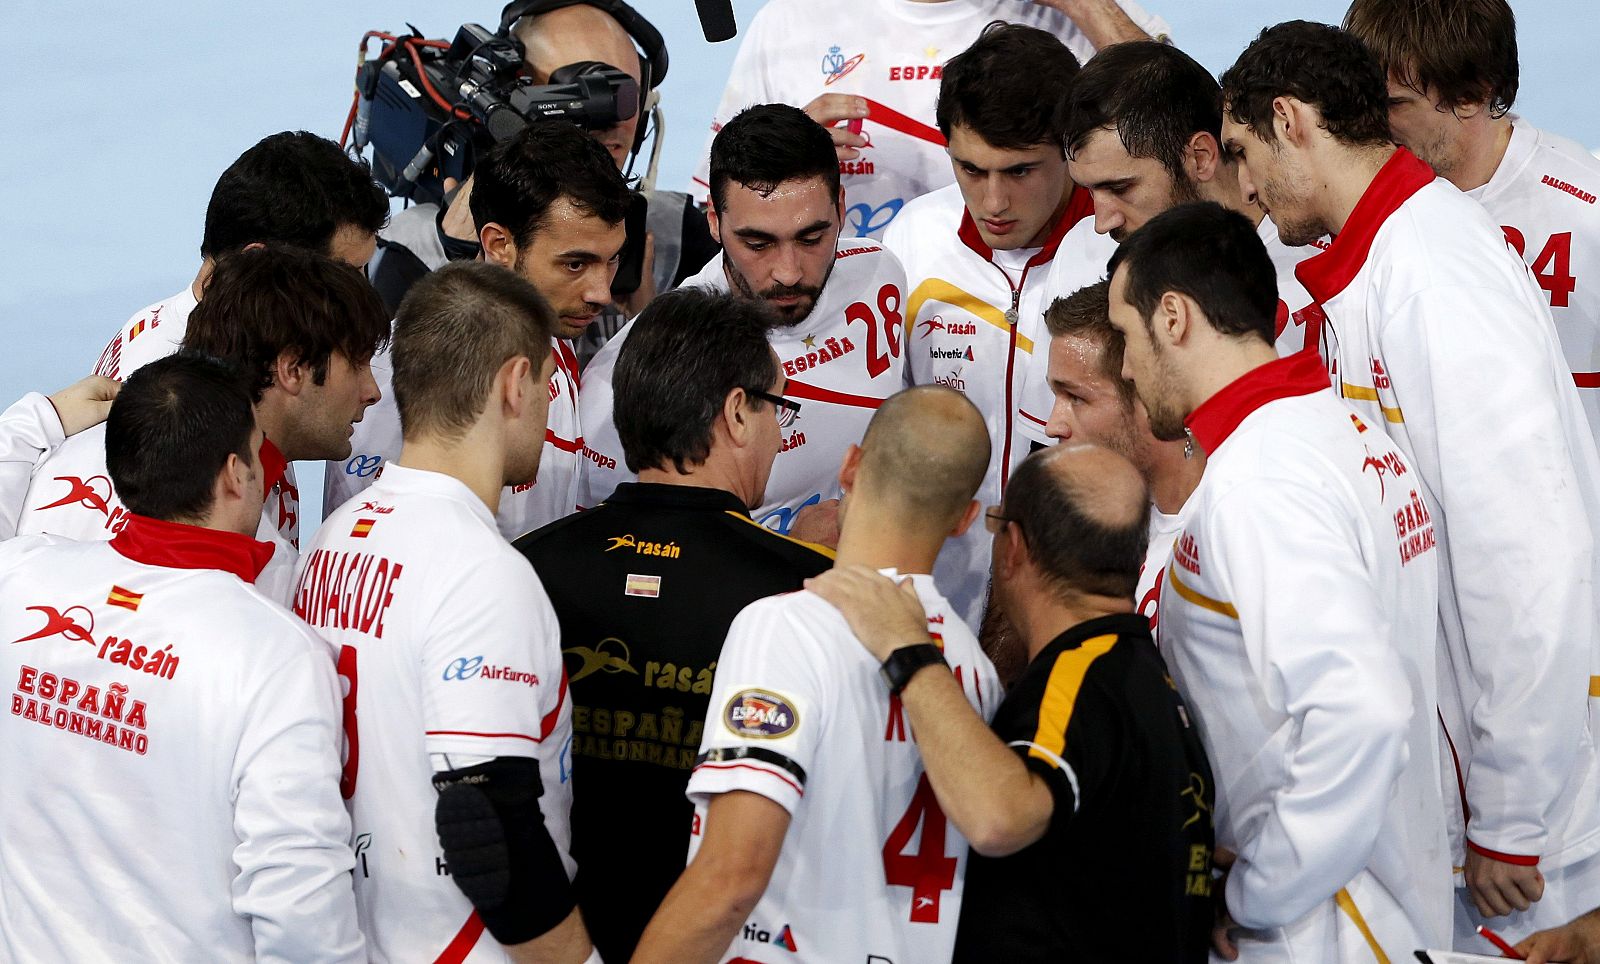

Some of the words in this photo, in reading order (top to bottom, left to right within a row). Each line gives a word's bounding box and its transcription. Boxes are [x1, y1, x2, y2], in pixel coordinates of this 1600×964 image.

[1541, 174, 1597, 204] BALONMANO
[844, 283, 903, 379] 28
[947, 320, 976, 335] rasán
[782, 336, 855, 377] ESPAÑA
[636, 541, 680, 559] rasán
[97, 643, 180, 680] rasán
[17, 664, 148, 730] ESPAÑA
[732, 705, 788, 728] ESPAÑA
[11, 693, 149, 756] BALONMANO
[882, 770, 958, 924] 4
